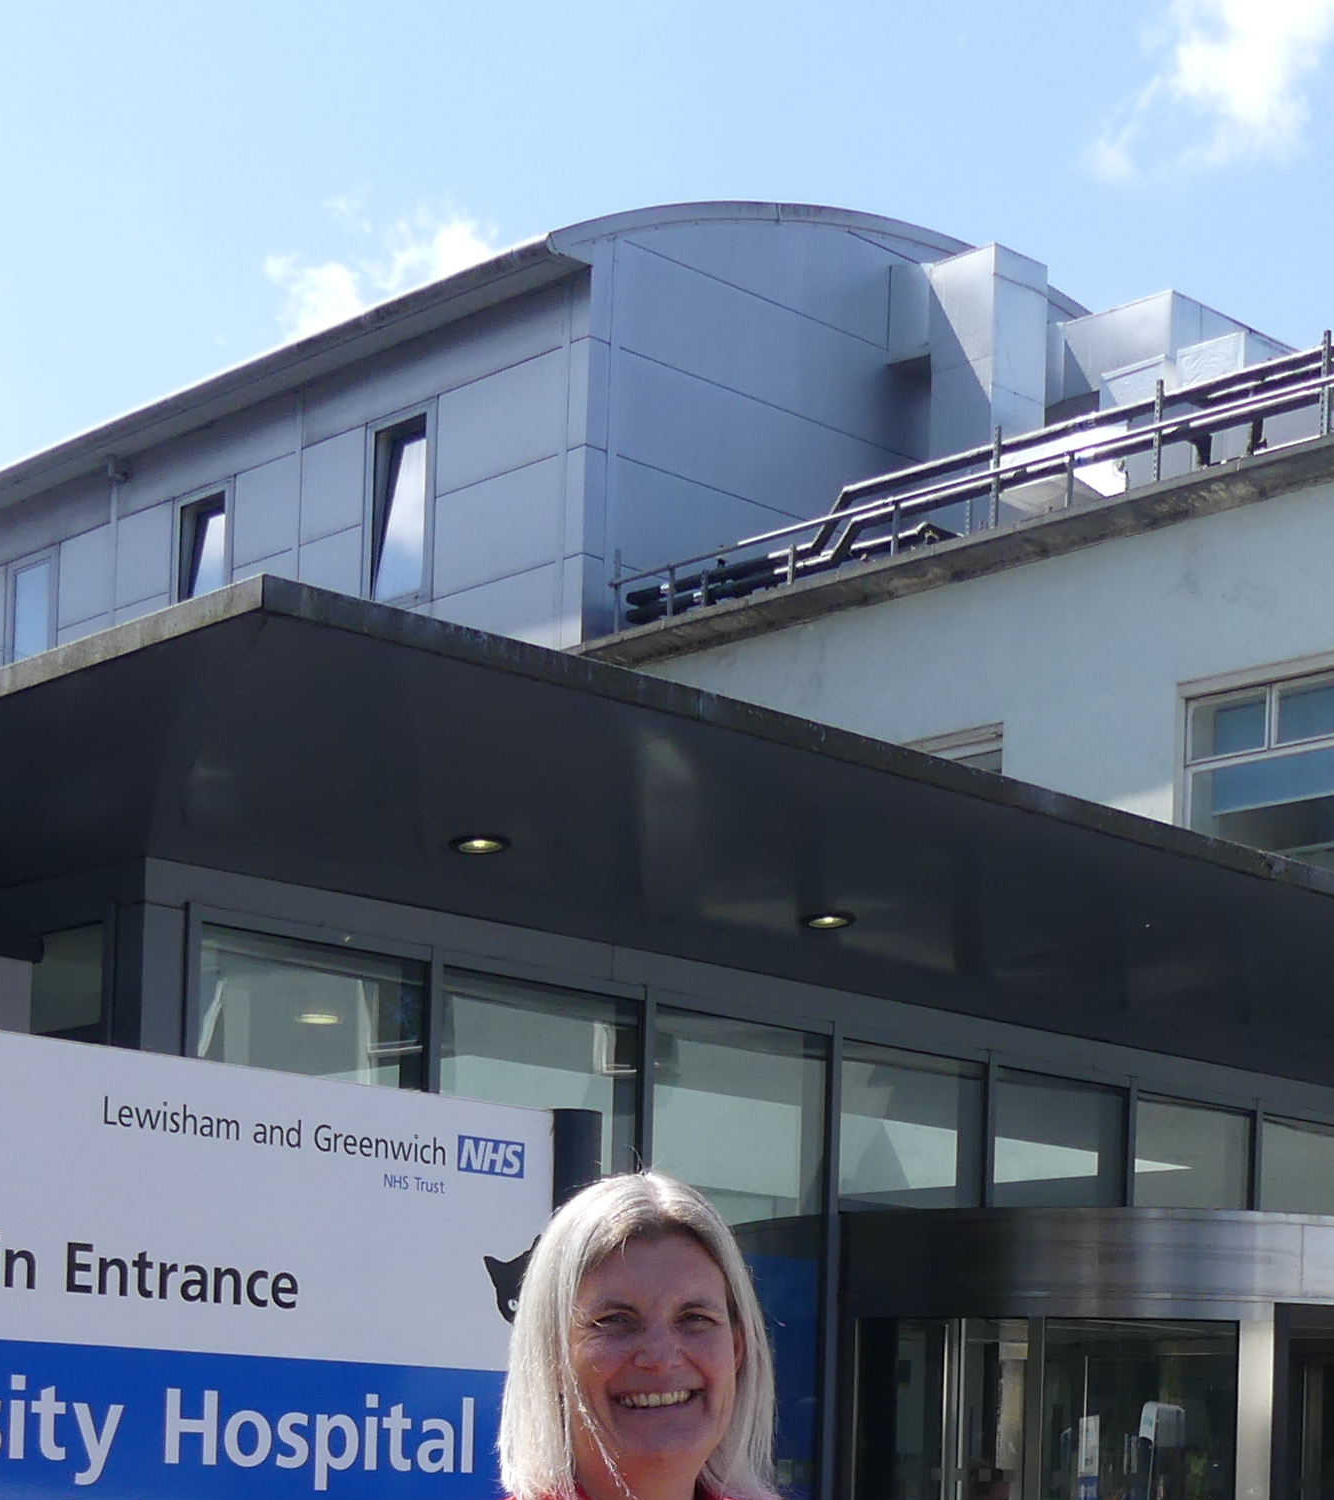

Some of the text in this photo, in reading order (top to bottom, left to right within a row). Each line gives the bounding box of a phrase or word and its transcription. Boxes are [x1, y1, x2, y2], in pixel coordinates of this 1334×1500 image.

[102, 1095, 524, 1178] Lewisham and Greenwich NHS
[383, 1173, 446, 1195] NHS Trust
[65, 1241, 300, 1310] Entrance
[164, 1387, 476, 1491] Hospital
